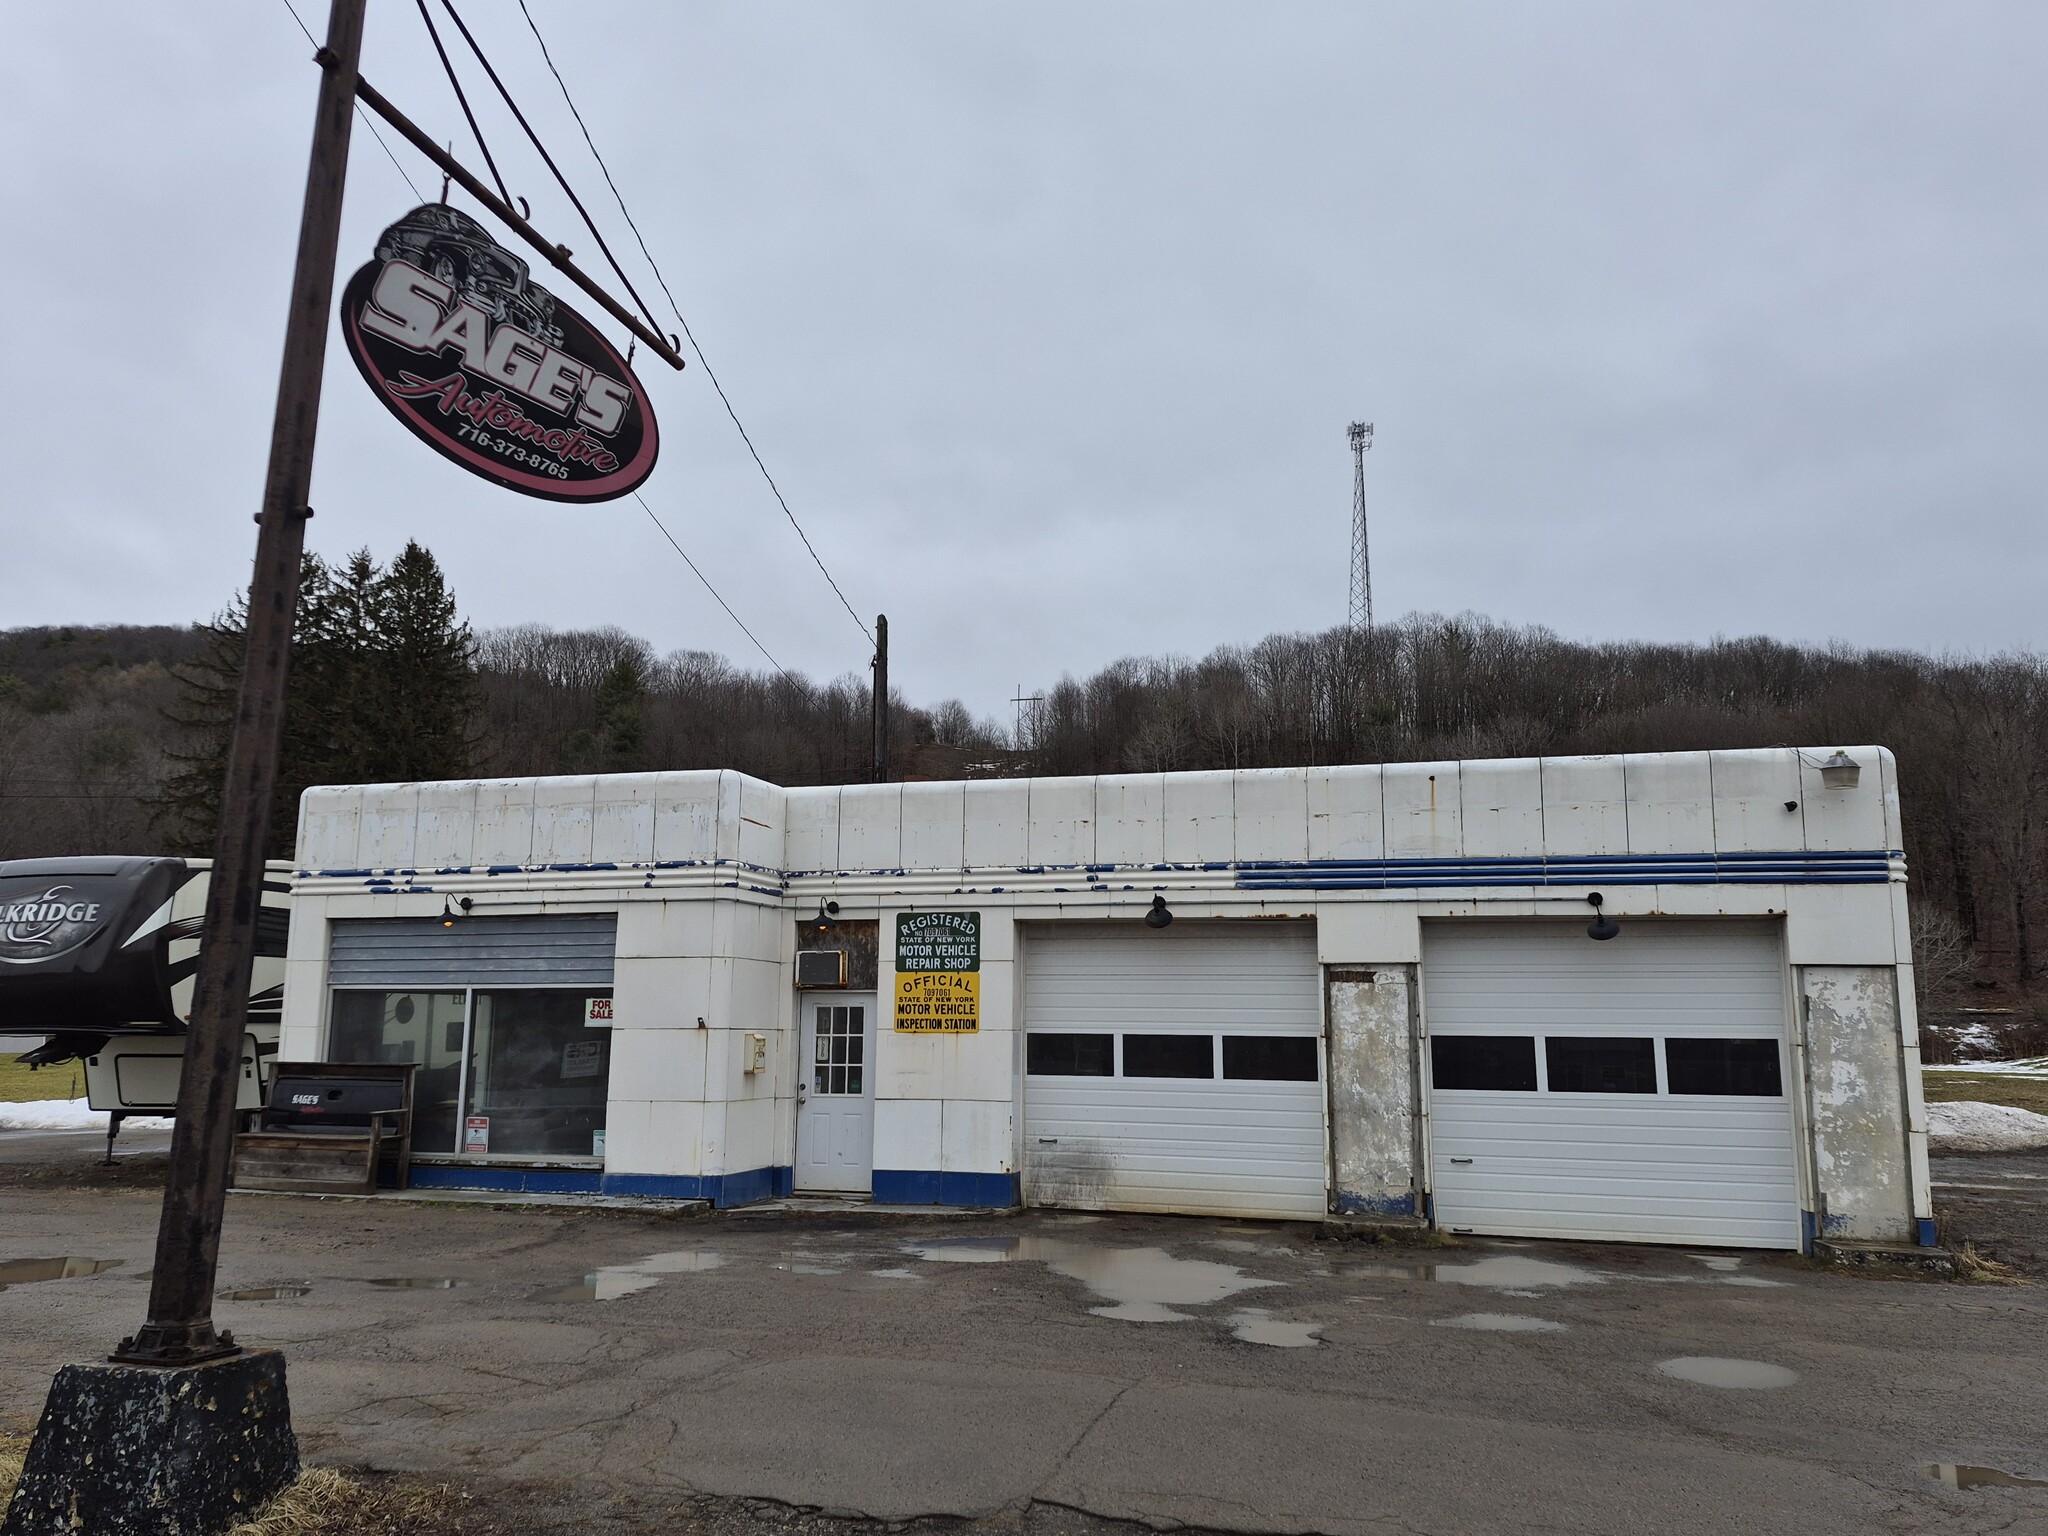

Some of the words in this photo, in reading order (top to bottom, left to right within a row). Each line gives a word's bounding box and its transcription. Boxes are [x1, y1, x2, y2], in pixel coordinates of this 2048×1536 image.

[358, 258, 634, 438] SAGE'S
[384, 370, 619, 473] Automotive
[456, 422, 570, 480] 716-373-8765
[900, 914, 976, 936] REGISTERED
[899, 945, 932, 956] MOTOR
[935, 944, 976, 956] VEHICLE
[905, 958, 940, 969] REPAIR
[944, 958, 971, 968] SHOP
[903, 975, 972, 993] OFFICIAL
[923, 988, 951, 997] 7097061
[592, 1000, 611, 1010] FOR
[898, 1004, 930, 1015] MOTOR
[934, 1004, 975, 1015] VEHICLE
[590, 1010, 613, 1019] SALE
[896, 1018, 942, 1029] INSPECTION
[944, 1018, 976, 1030] STATION
